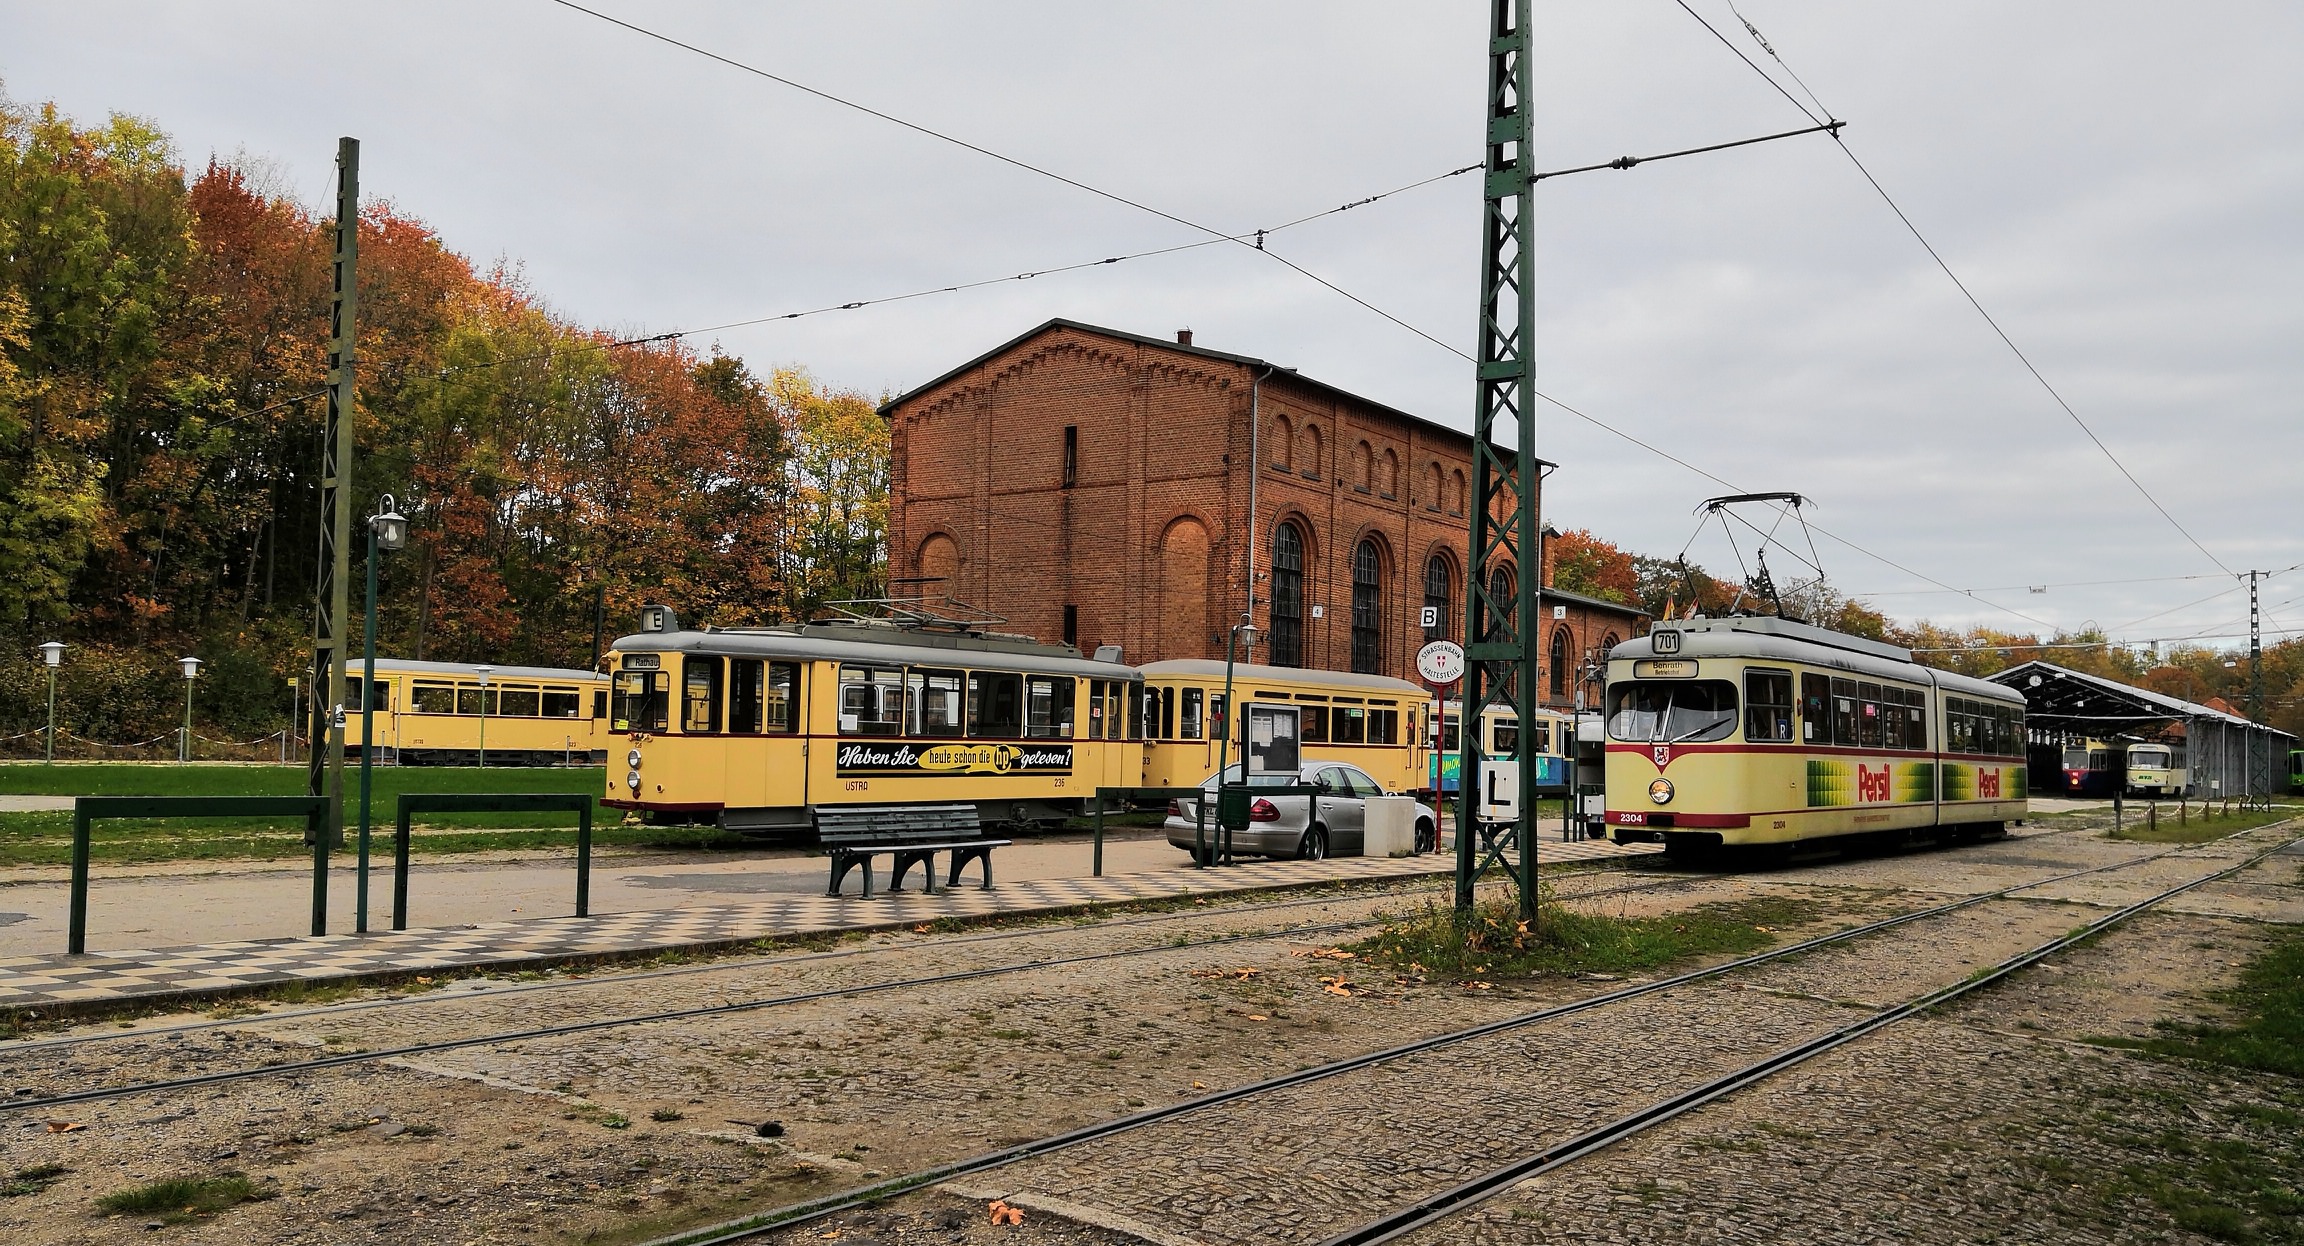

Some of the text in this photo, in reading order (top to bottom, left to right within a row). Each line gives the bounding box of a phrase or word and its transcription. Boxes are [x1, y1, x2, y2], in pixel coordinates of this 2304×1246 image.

[653, 612, 662, 628] E
[1424, 610, 1435, 624] B
[1658, 634, 1677, 649] 701
[1421, 645, 1462, 660] STRASSENBAHN
[635, 657, 659, 667] Rathau
[1652, 660, 1683, 669] Benrath
[1423, 665, 1460, 679] HALTESTELLE
[1780, 724, 1786, 739] R
[838, 744, 890, 768] Haben
[890, 744, 919, 766] Sie
[954, 748, 977, 764] schon
[978, 750, 991, 764] die
[1020, 748, 1072, 770] gelesen?
[1488, 770, 1511, 806] L
[1858, 763, 1891, 803] Persil
[1978, 767, 2000, 799] Persil
[1620, 813, 1643, 823] 2304
[1773, 820, 1786, 830] 2304
